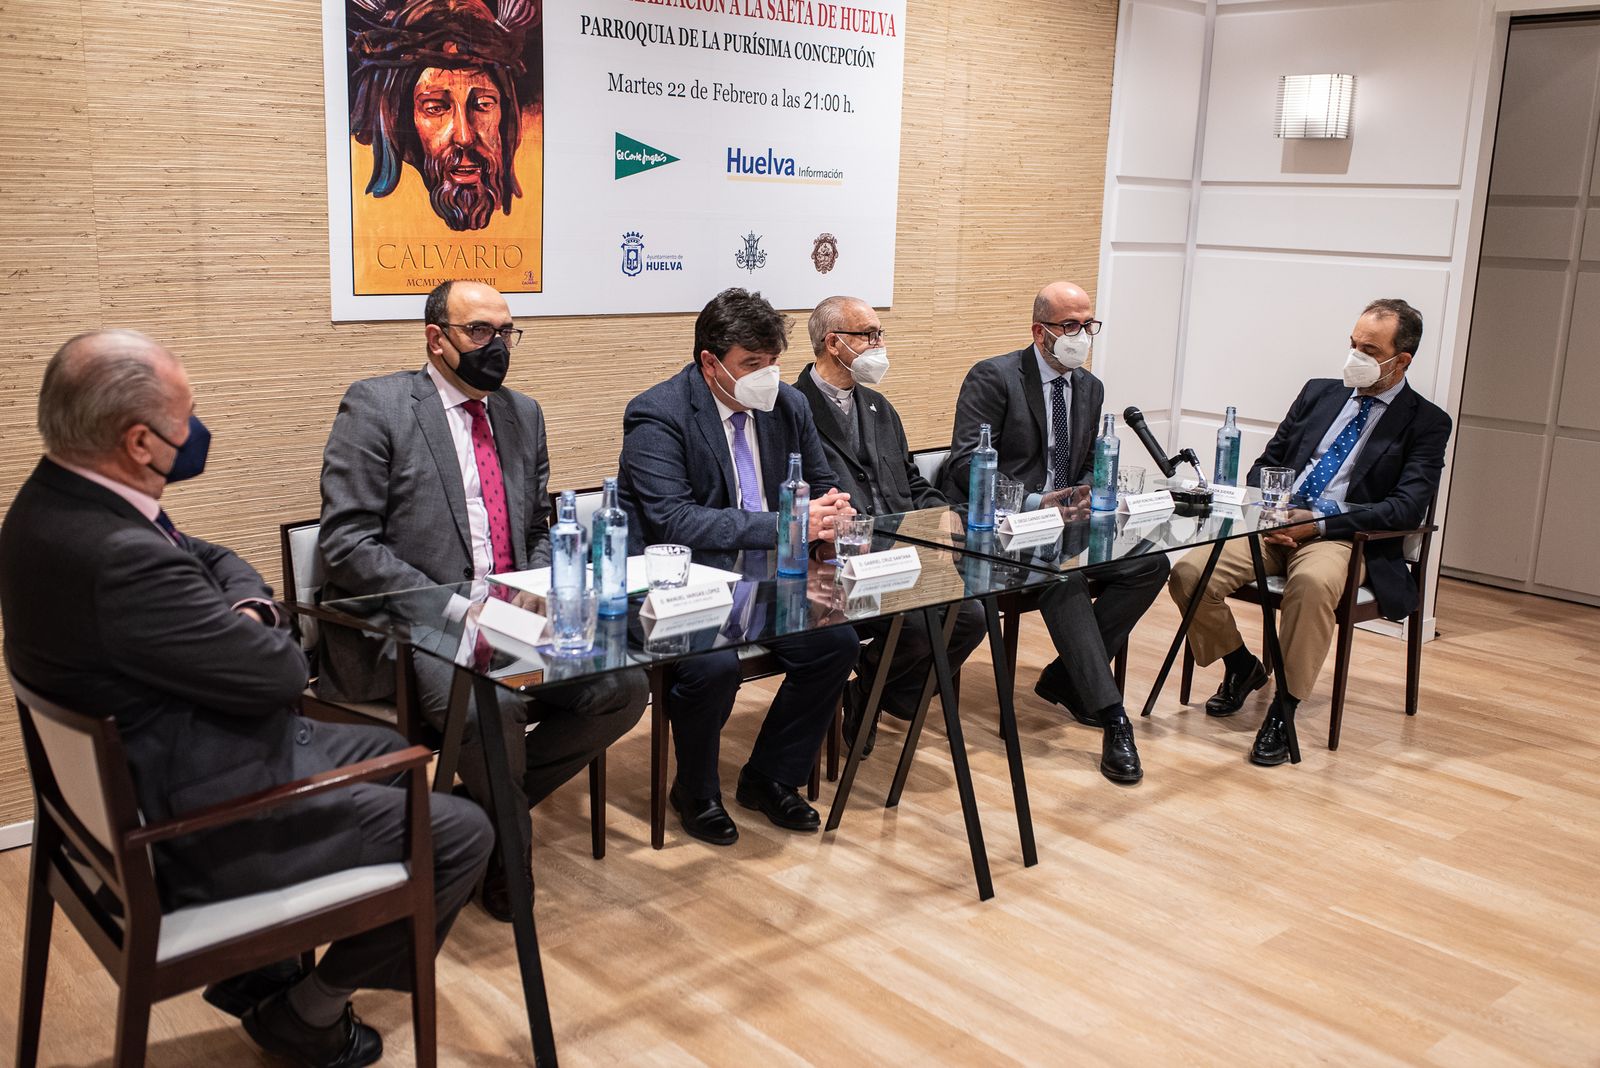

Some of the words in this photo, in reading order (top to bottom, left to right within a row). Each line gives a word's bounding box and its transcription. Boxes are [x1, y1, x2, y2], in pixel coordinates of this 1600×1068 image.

[743, 0, 764, 19] LA
[767, 0, 815, 26] SAETA
[817, 3, 837, 29] DE
[840, 6, 897, 37] HUELVA
[580, 14, 675, 47] PARROQUIA
[678, 27, 699, 48] DE
[701, 30, 721, 51] LA
[723, 31, 792, 59] PURÍSIMA
[794, 41, 876, 69] CONCEPCIÓN
[607, 72, 664, 96] Martes
[667, 82, 686, 98] 22
[690, 79, 708, 100] de
[712, 82, 768, 106] Febrero
[771, 93, 779, 107] a
[782, 88, 801, 109] las
[804, 91, 840, 112] 21:00
[843, 94, 855, 113] h.
[726, 147, 795, 177] Huelva
[798, 166, 844, 179] Información
[376, 243, 523, 271] CALVARIO
[646, 261, 683, 271] HUELVA
